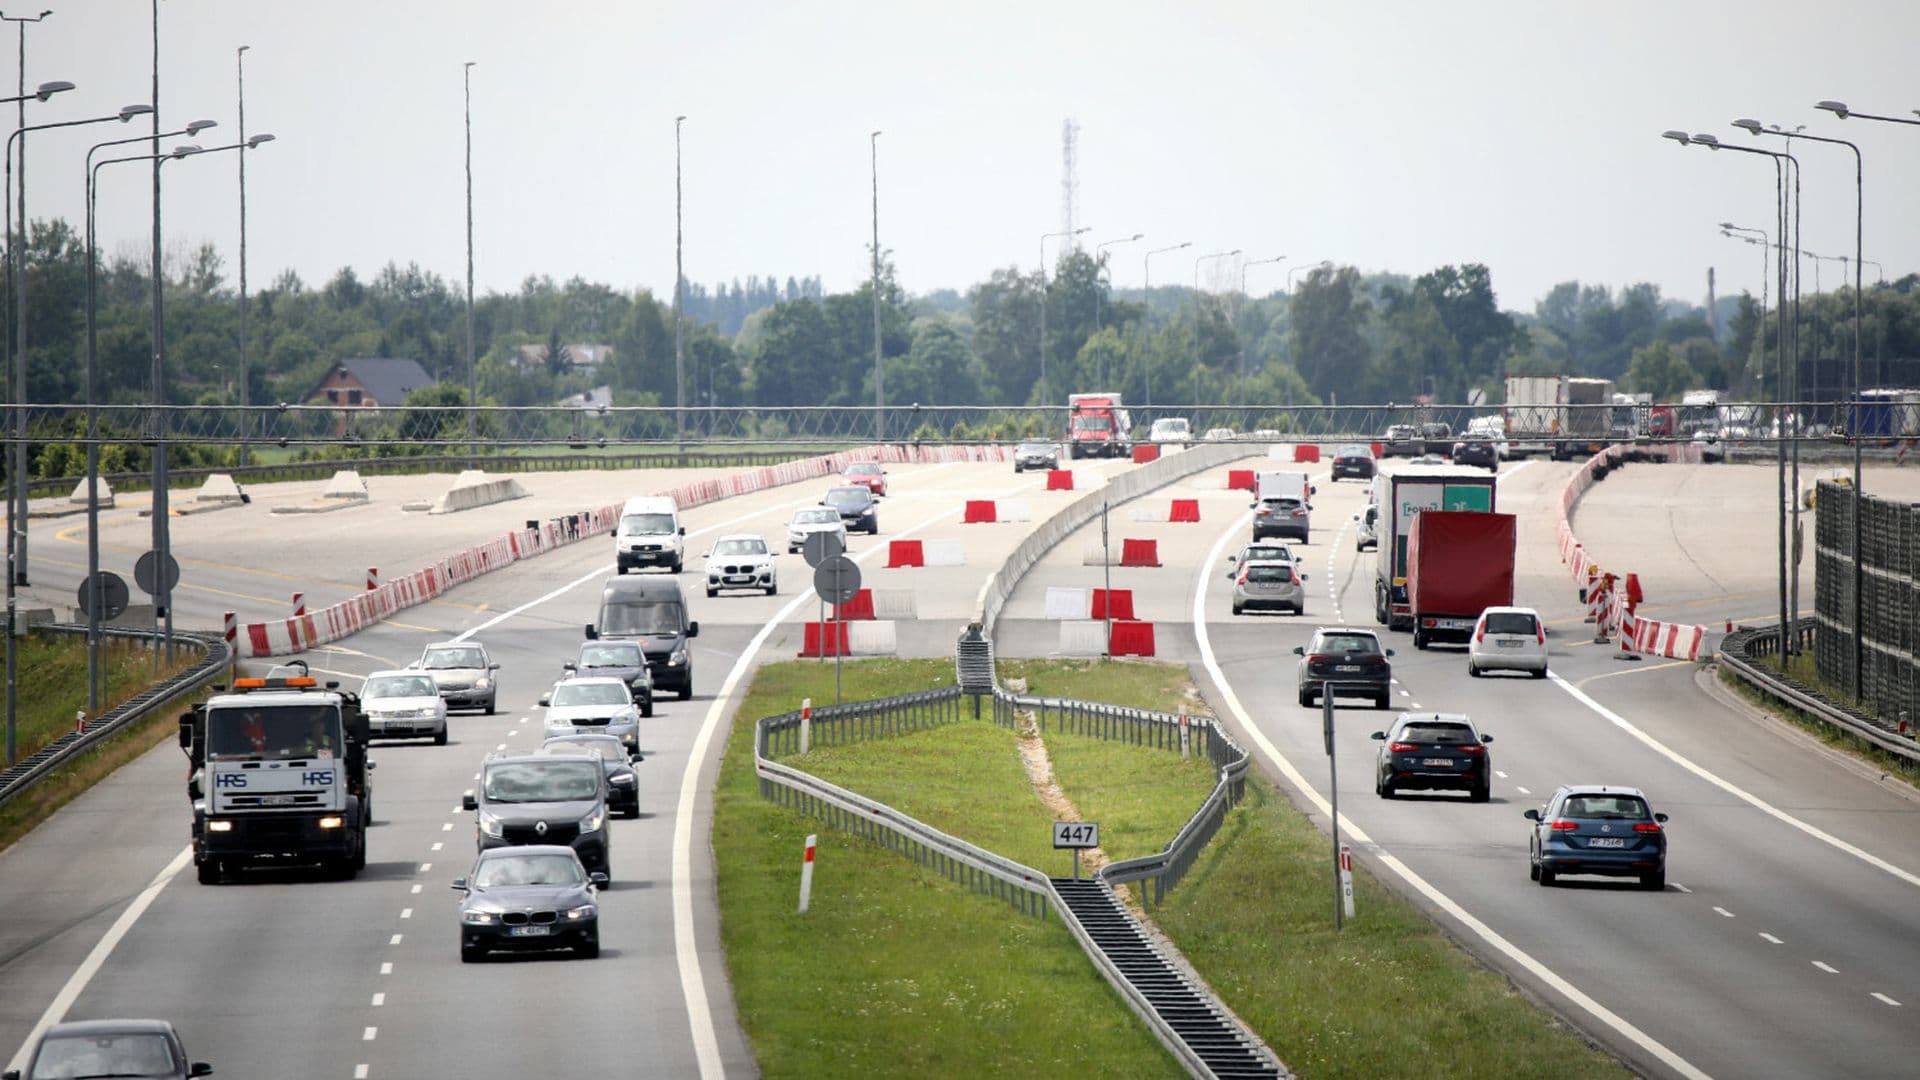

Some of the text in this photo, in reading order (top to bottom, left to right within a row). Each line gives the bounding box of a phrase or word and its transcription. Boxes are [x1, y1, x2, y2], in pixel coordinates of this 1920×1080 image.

[217, 774, 247, 787] HRS
[302, 772, 333, 785] HRS
[1060, 826, 1093, 842] 447
